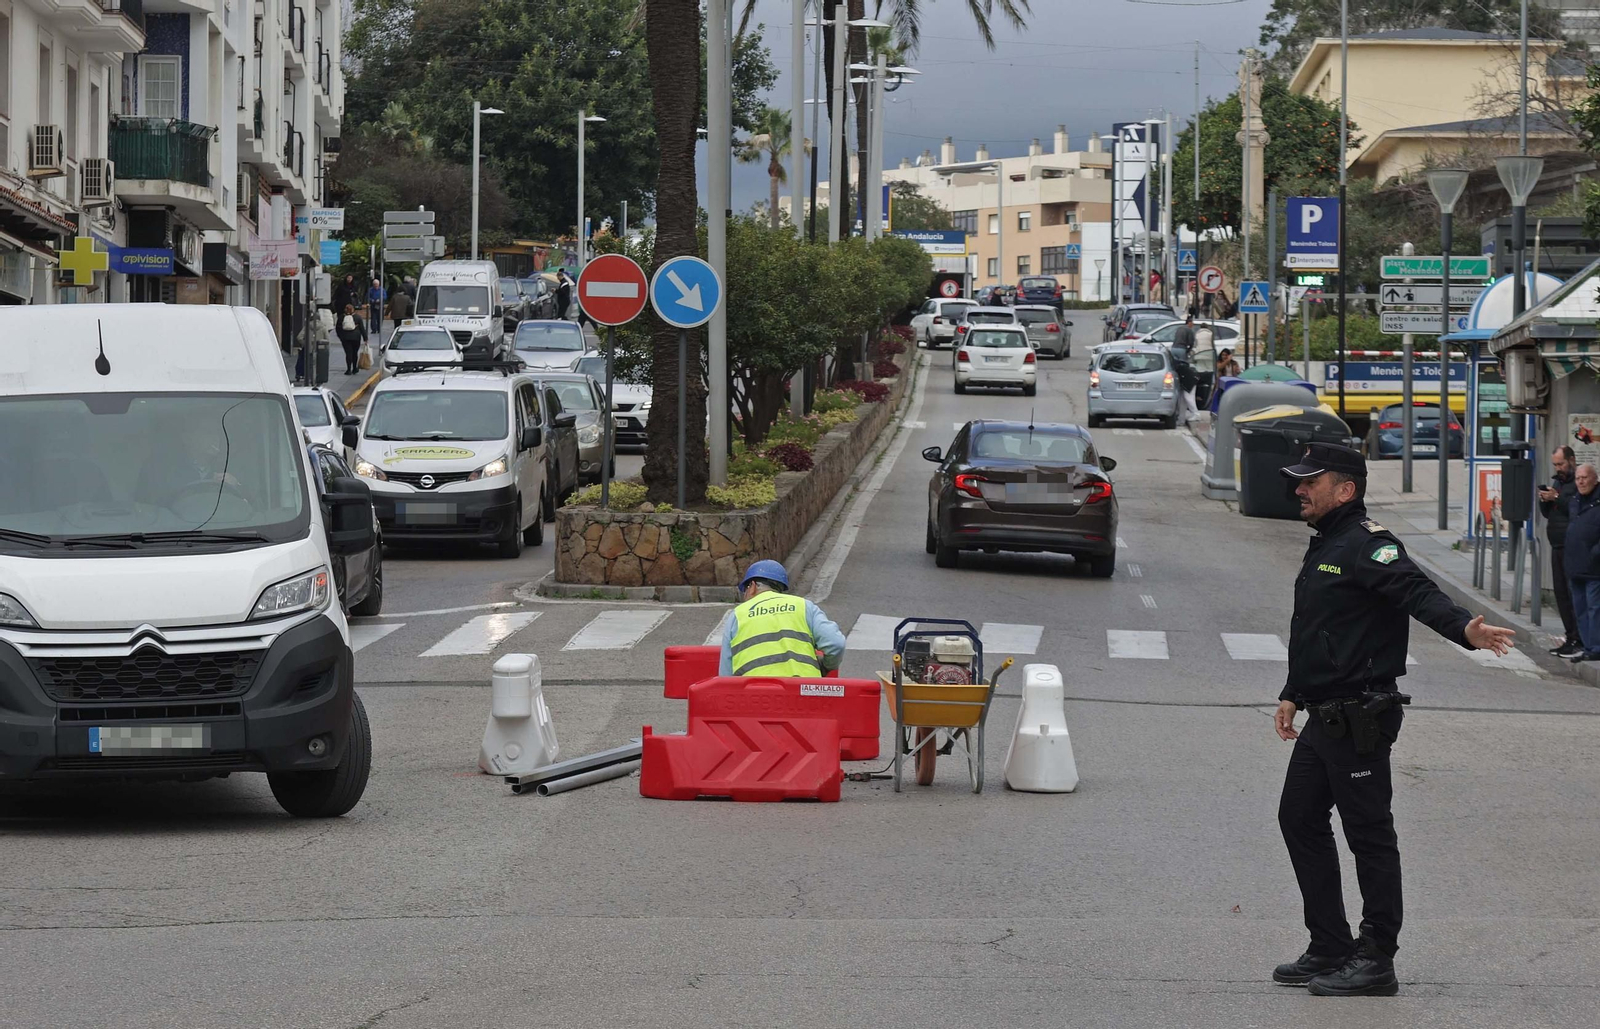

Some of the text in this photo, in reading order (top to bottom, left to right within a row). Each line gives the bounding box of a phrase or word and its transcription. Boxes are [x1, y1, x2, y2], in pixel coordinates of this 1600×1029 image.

[312, 216, 328, 224] 0%
[1301, 204, 1323, 233] P
[1298, 276, 1324, 286] LIBRE
[1328, 365, 1339, 378] P
[1317, 564, 1342, 574] POLICIA
[748, 603, 796, 618] albaida
[1350, 770, 1372, 778] POLICIA
